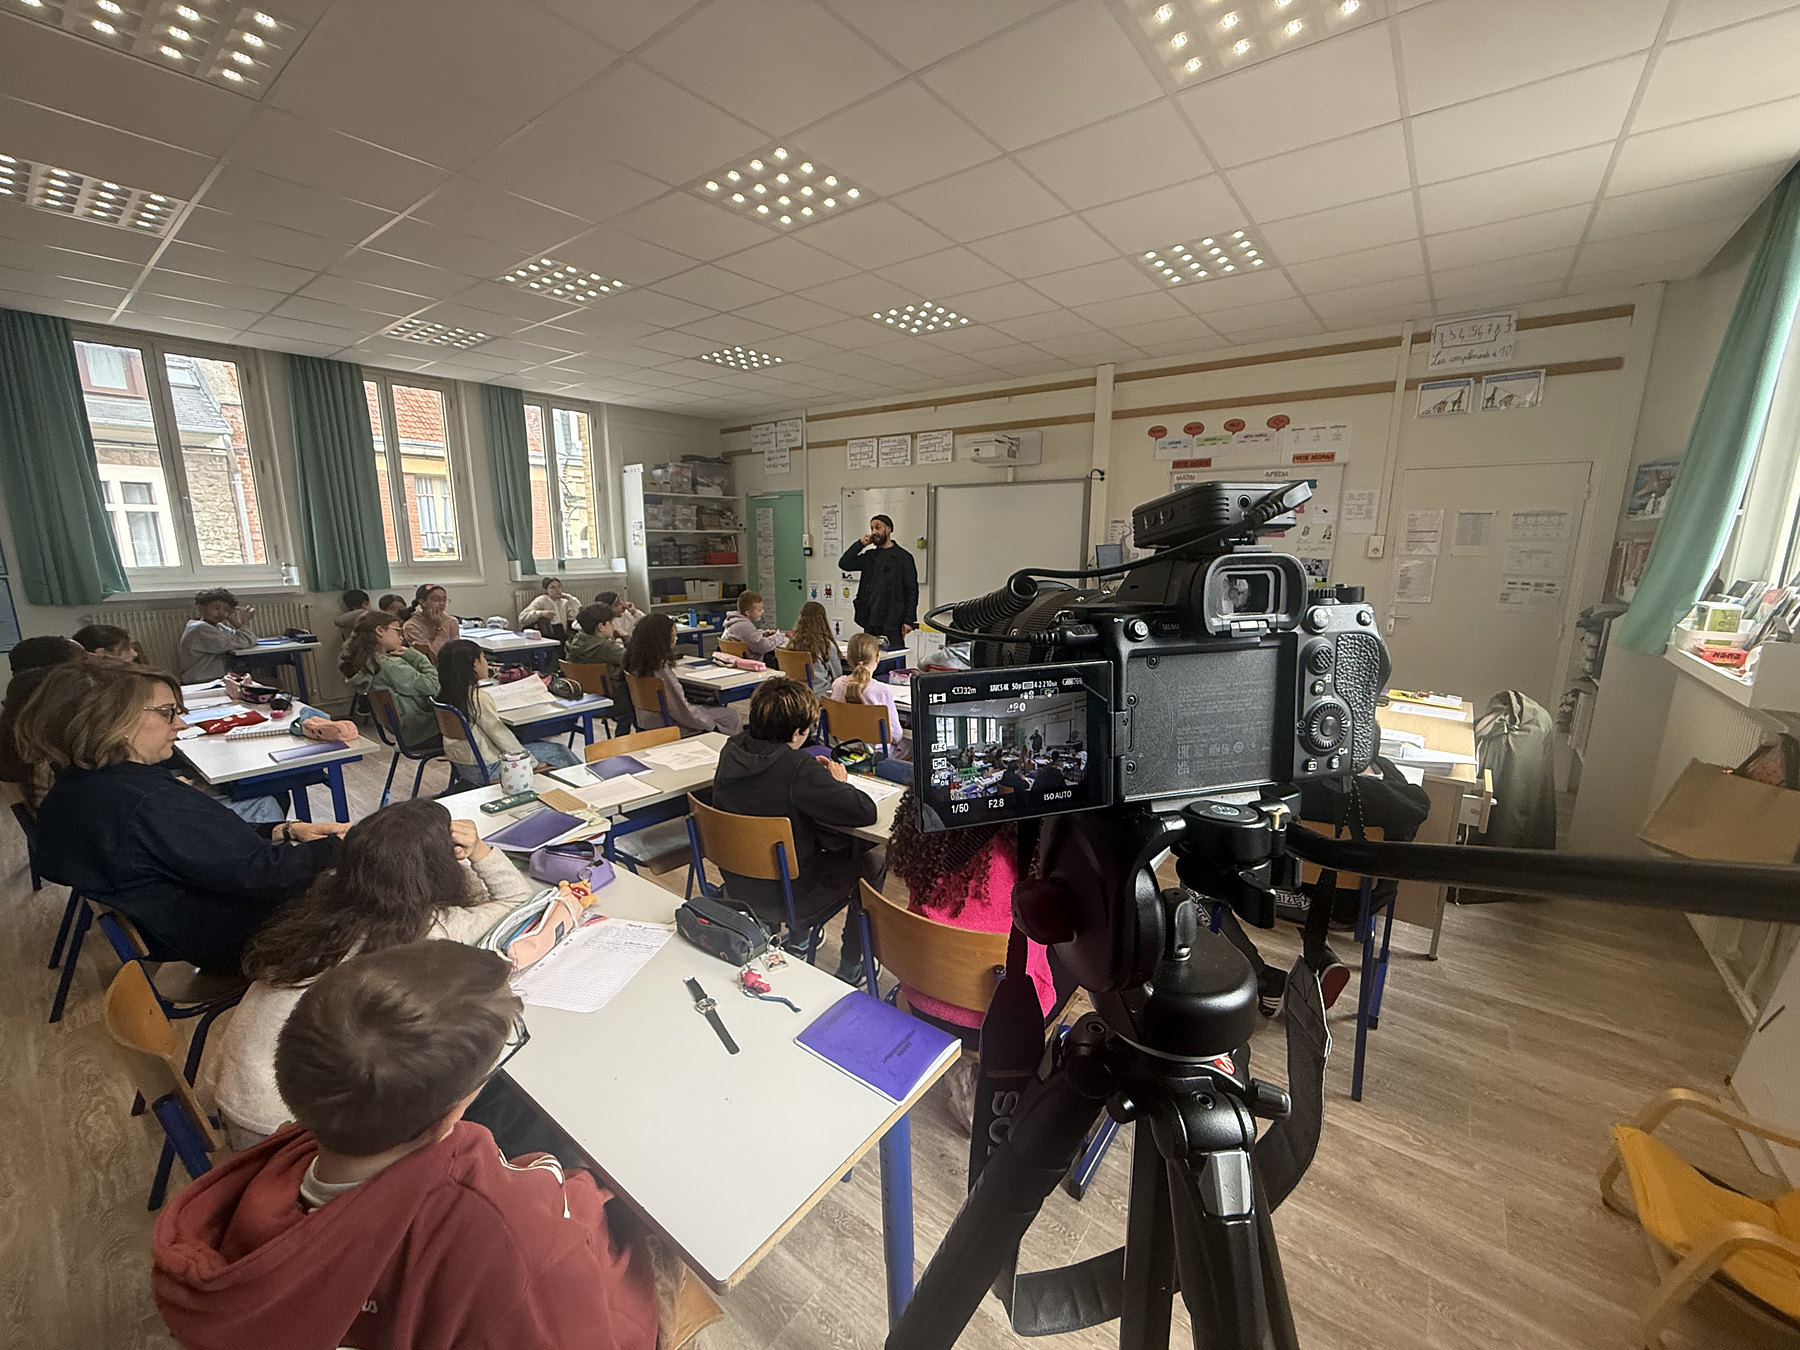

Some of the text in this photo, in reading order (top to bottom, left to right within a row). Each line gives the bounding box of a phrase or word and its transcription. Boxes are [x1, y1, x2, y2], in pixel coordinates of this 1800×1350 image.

[1499, 344, 1513, 357] 10
[963, 686, 977, 695] 32m
[951, 790, 1072, 813] 1/50 F2.8 ISO AUTO
